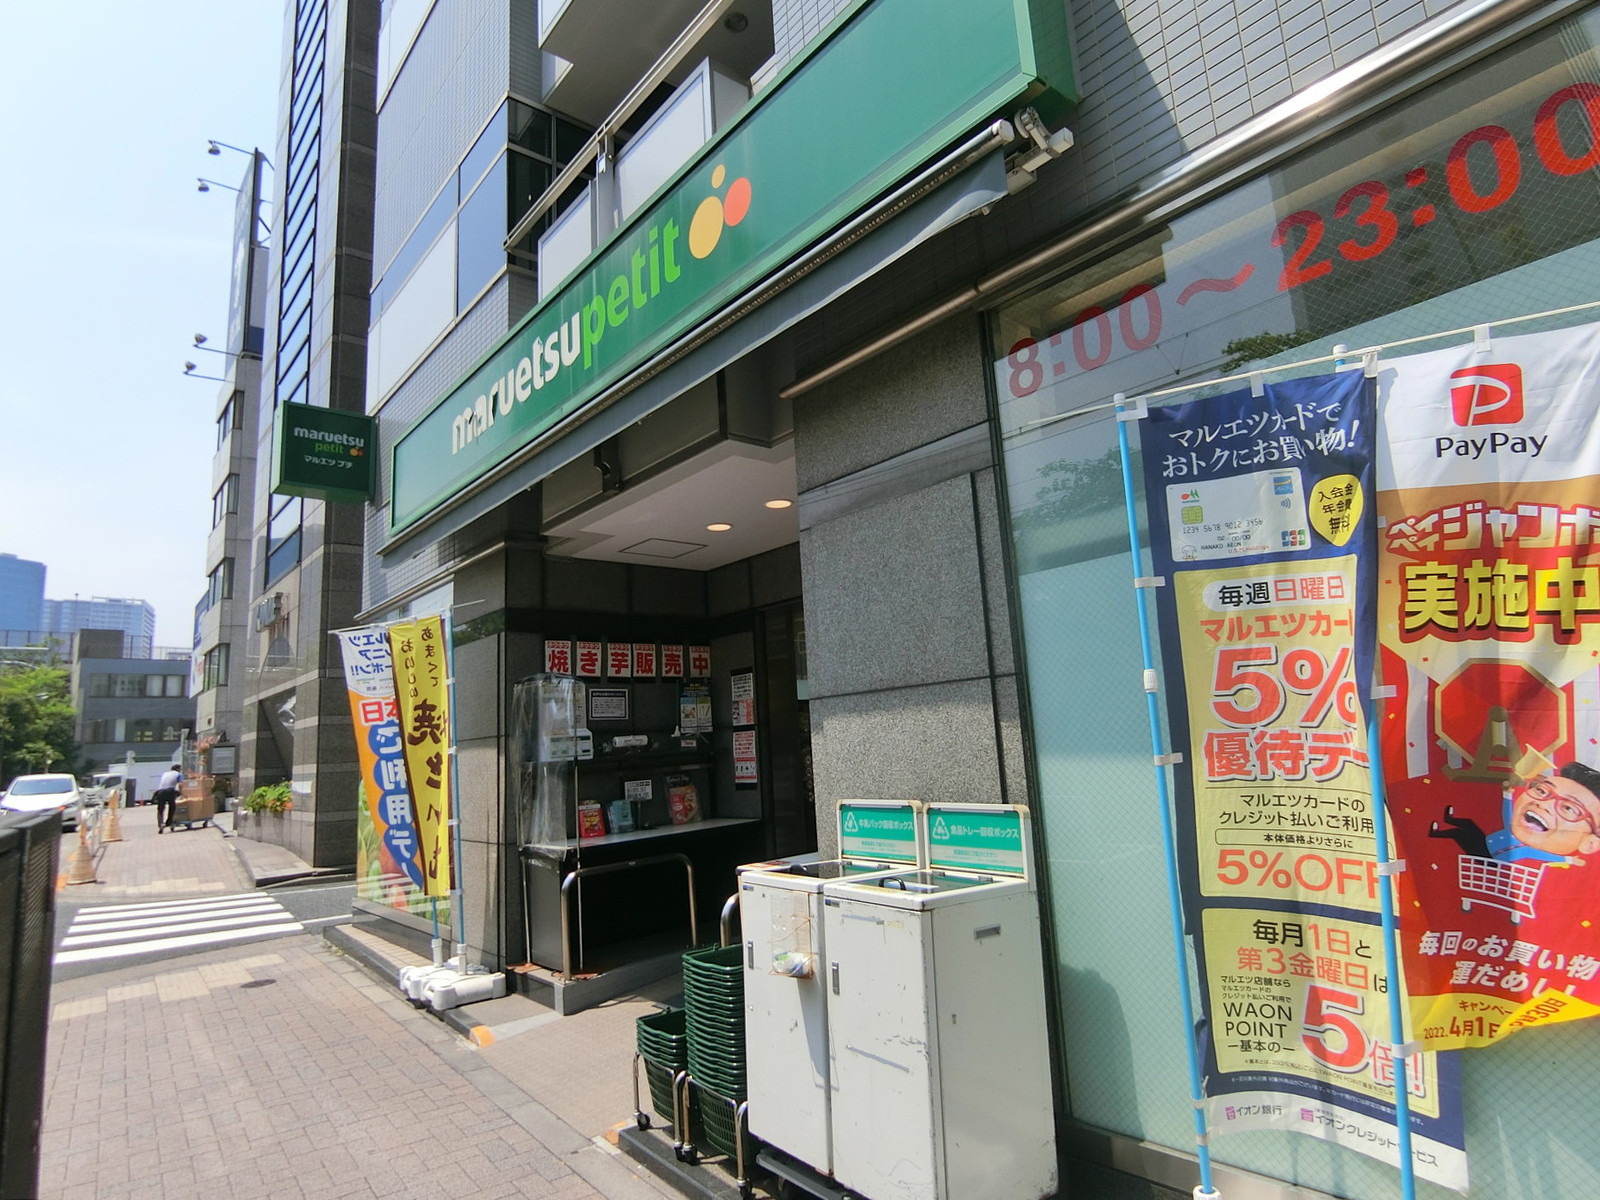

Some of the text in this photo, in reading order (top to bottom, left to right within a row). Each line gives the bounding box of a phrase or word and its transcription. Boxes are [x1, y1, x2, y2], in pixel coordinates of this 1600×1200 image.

[293, 426, 365, 448] maruetsu
[1435, 433, 1548, 460] PayPay
[314, 442, 344, 455] petit
[1318, 483, 1354, 503] 入会金
[1218, 575, 1345, 607] 毎週日曜日
[1404, 557, 1600, 631] 実施中
[1212, 646, 1357, 727] 5%
[1239, 793, 1365, 813] マルエツカードの
[950, 824, 1019, 839] 食品トレー回収ボックス
[1263, 833, 1353, 849] 本体価格よりさらに
[1252, 918, 1373, 960] 毎月1日と
[1418, 931, 1600, 981] 毎回のお買い物
[1220, 975, 1291, 988] マルエツ店舗なら
[1223, 1002, 1293, 1021] WAON
[1459, 1000, 1514, 1016] キャンペー
[1226, 1021, 1288, 1039] POINT
[1236, 1104, 1283, 1117] イオン銀行
[1314, 1113, 1438, 1167] イオンクレジットビス
